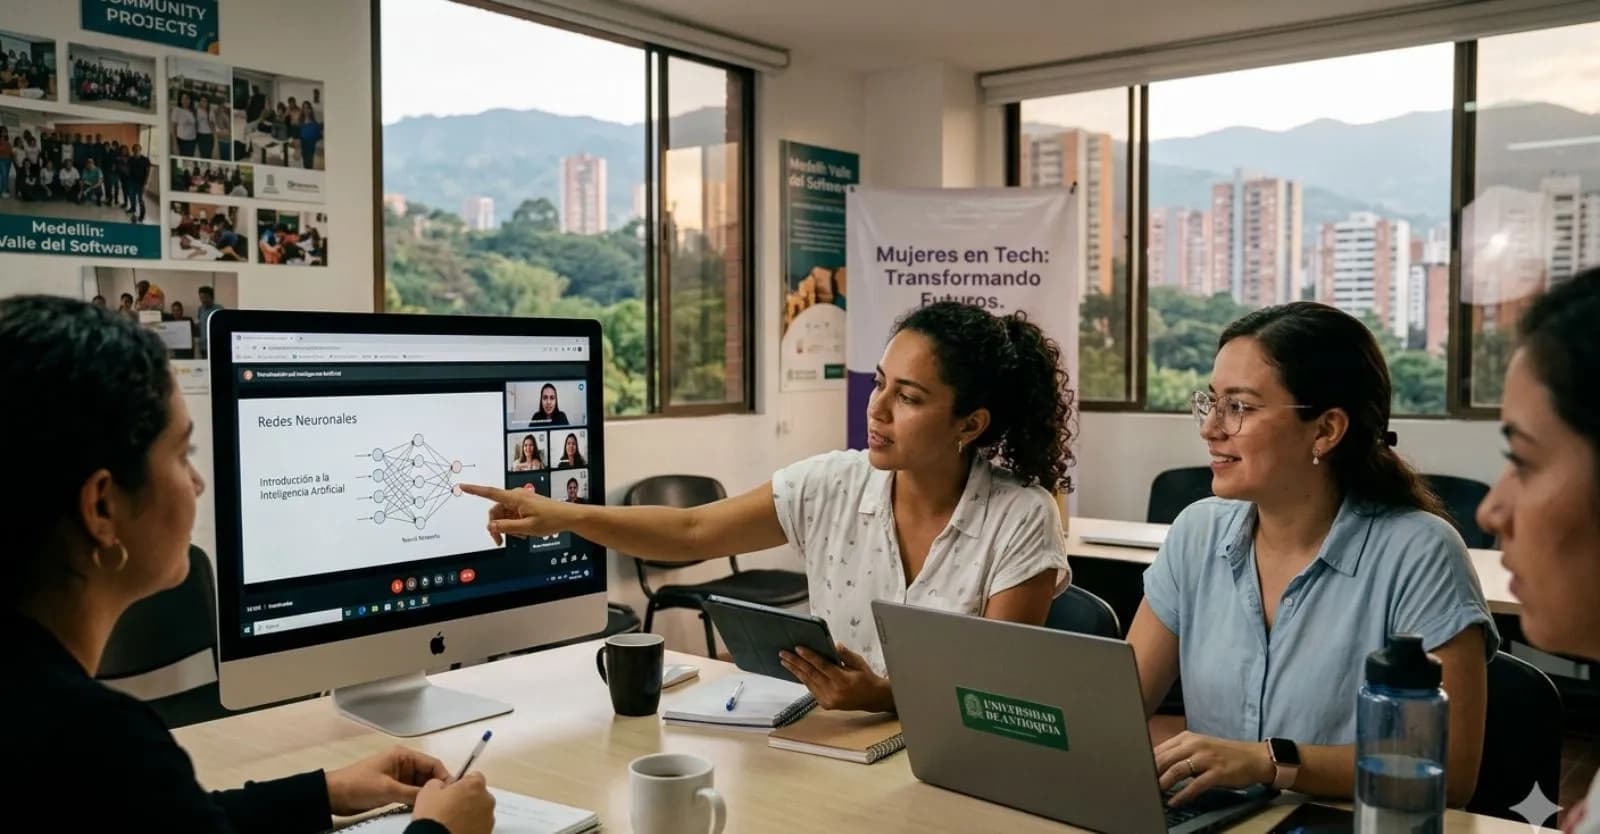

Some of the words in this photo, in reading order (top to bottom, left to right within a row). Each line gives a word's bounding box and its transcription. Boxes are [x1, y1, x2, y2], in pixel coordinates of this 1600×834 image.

[102, 0, 207, 20] MMUNITY
[106, 8, 198, 37] PROJECTS
[41, 237, 66, 251] del
[70, 239, 139, 256] Software
[876, 245, 959, 266] Mujeres
[964, 249, 989, 263] en
[994, 246, 1050, 263] Tech:
[884, 269, 1041, 286] Transformando
[258, 415, 292, 428] Redes
[296, 412, 358, 426] Neuronales
[259, 474, 314, 487] Introducción
[322, 472, 330, 482] la
[260, 486, 309, 501] Inteligencia
